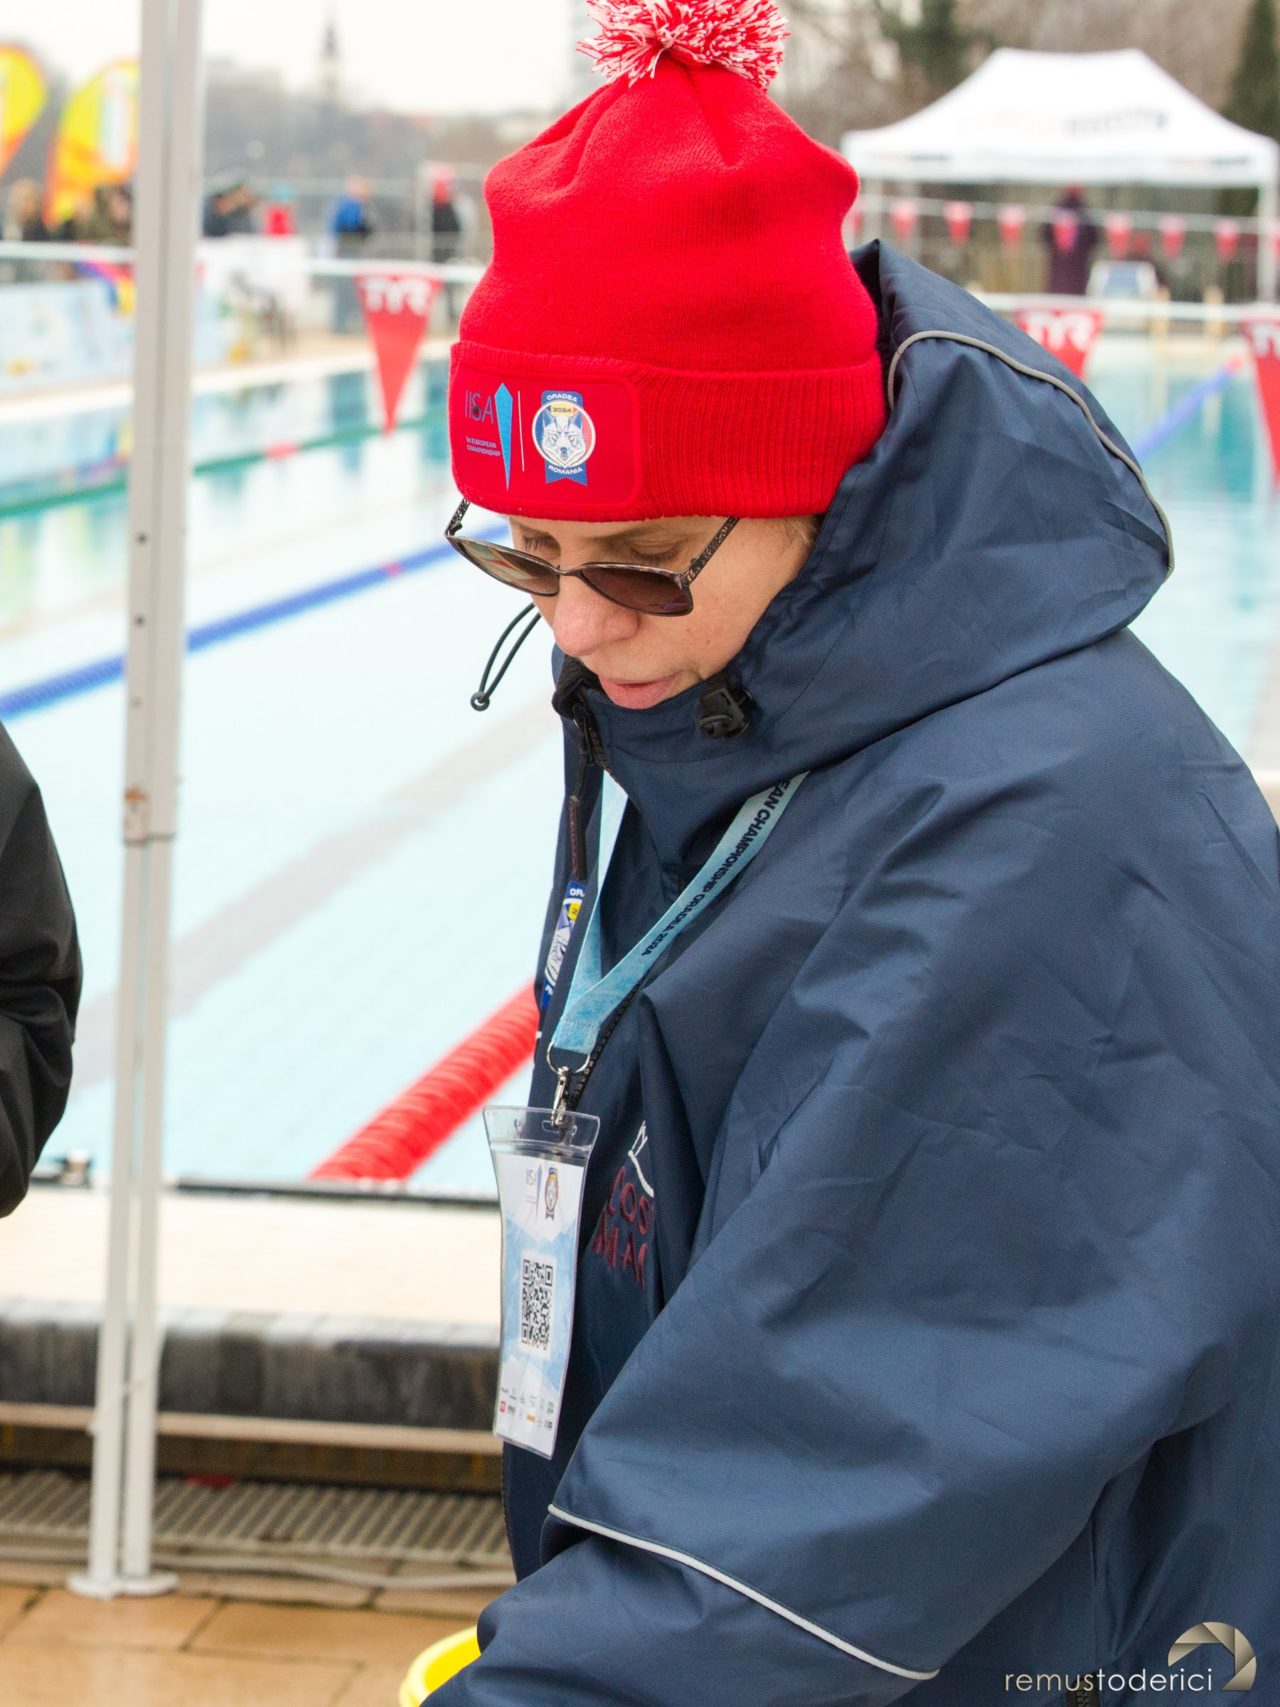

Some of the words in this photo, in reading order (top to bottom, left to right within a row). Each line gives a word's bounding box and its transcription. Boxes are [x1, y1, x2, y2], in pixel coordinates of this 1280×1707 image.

[364, 277, 430, 315] TYR
[465, 389, 495, 424] IISA
[546, 393, 578, 403] ORADEA
[548, 464, 583, 475] ROMANIA
[702, 809, 771, 893] CHAMPIONSHIP
